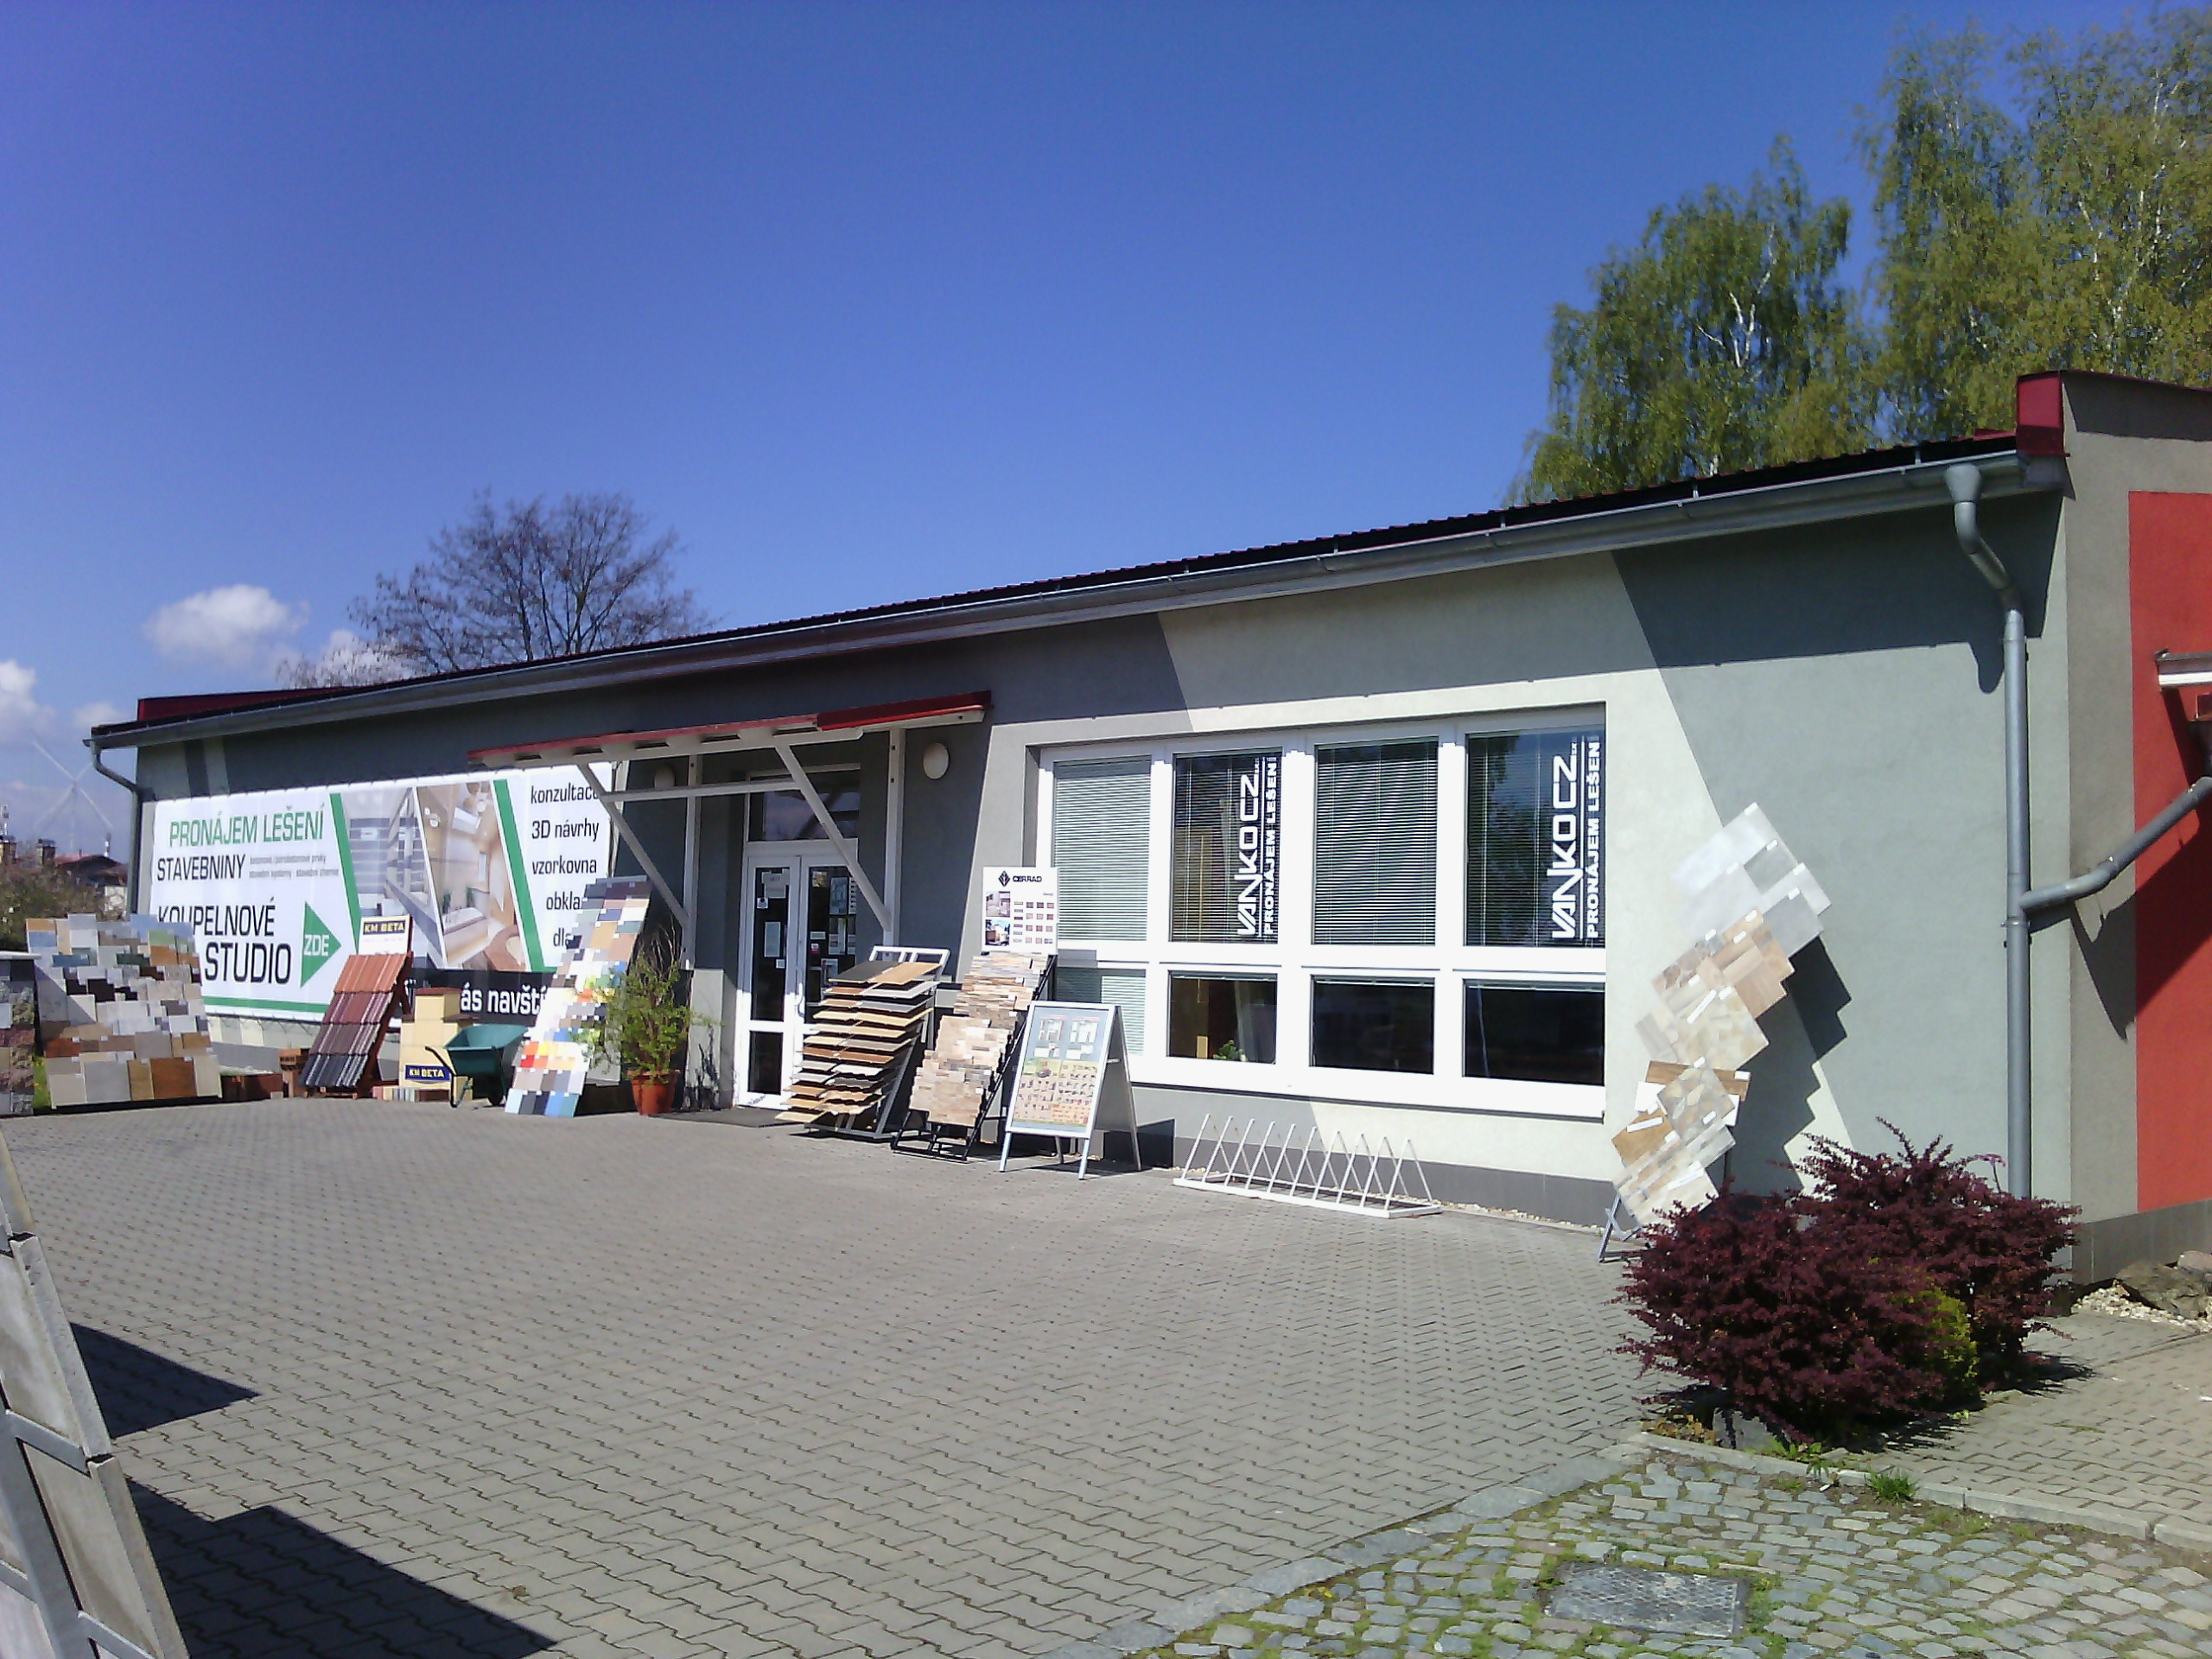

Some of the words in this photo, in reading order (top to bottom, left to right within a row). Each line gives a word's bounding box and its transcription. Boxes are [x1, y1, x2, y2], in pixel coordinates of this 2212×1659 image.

[1240, 774, 1259, 822] CZ
[1264, 757, 1277, 824] LEŠENÍ
[1553, 755, 1577, 809] CZ
[169, 810, 257, 848] PRONÁJEM
[263, 802, 325, 842] LEŠENÍ
[531, 819, 550, 840] 3D
[555, 817, 600, 842] návrhy
[157, 854, 245, 881] STAVEBNINY
[532, 855, 597, 874] vzorkovna
[1234, 825, 1262, 936] VANKO
[1263, 830, 1276, 935] PRONÁJEM
[1548, 814, 1583, 938] VANKO
[1585, 817, 1599, 938] PRONÁJEM
[546, 891, 581, 910] obkla
[304, 934, 328, 957] ZDE
[365, 923, 378, 932] KM
[380, 922, 404, 932] BETA
[205, 941, 291, 984] STUDIO
[461, 982, 483, 1012] ás
[421, 1069, 445, 1078] BETA
